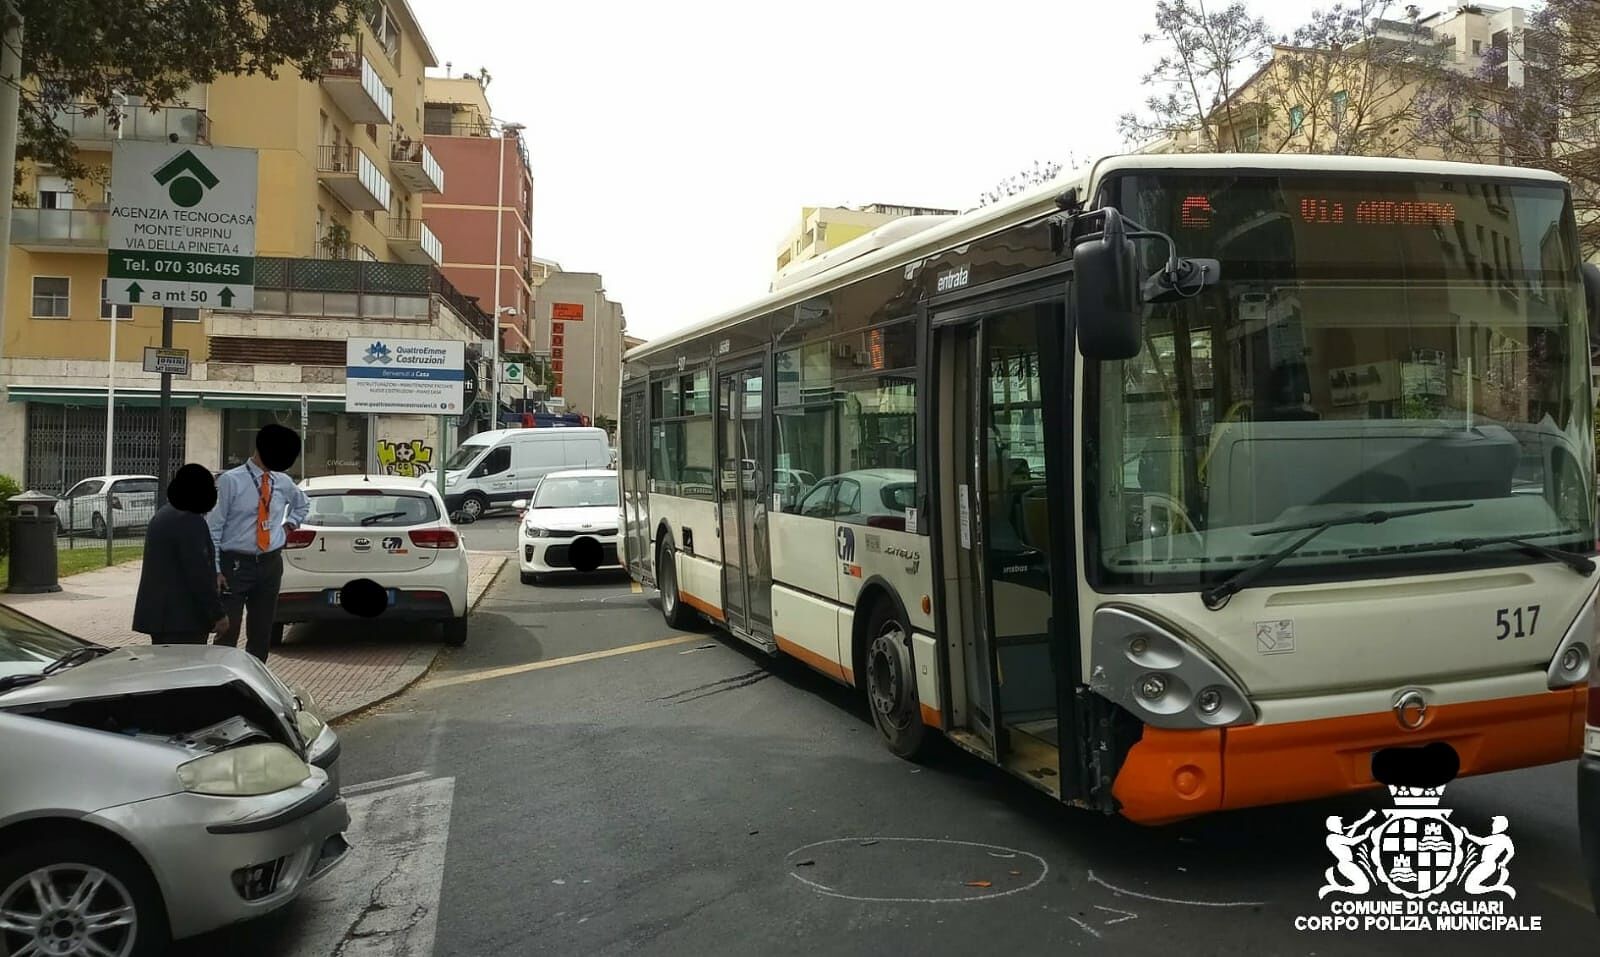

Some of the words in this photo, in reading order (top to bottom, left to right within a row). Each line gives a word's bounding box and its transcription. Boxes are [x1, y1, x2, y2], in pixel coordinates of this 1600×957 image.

[112, 206, 169, 220] AGENZIA
[173, 210, 255, 225] TECNOCASA
[1182, 196, 1211, 228] C
[1301, 200, 1344, 223] Via
[186, 227, 232, 239] URPINU
[125, 238, 145, 249] VIA
[148, 239, 186, 251] DELLA
[188, 240, 232, 254] PINETA
[232, 244, 239, 254] 4
[123, 258, 150, 271] Tel.
[154, 260, 182, 273] 070
[186, 261, 240, 276] 306455
[937, 265, 969, 292] entrata
[152, 291, 161, 300] a
[166, 290, 186, 302] mt
[190, 290, 208, 302] 50
[396, 346, 447, 355] QuattroEmme
[396, 354, 446, 365] Costruzioni
[319, 537, 327, 552] 1
[1496, 605, 1540, 640] 517
